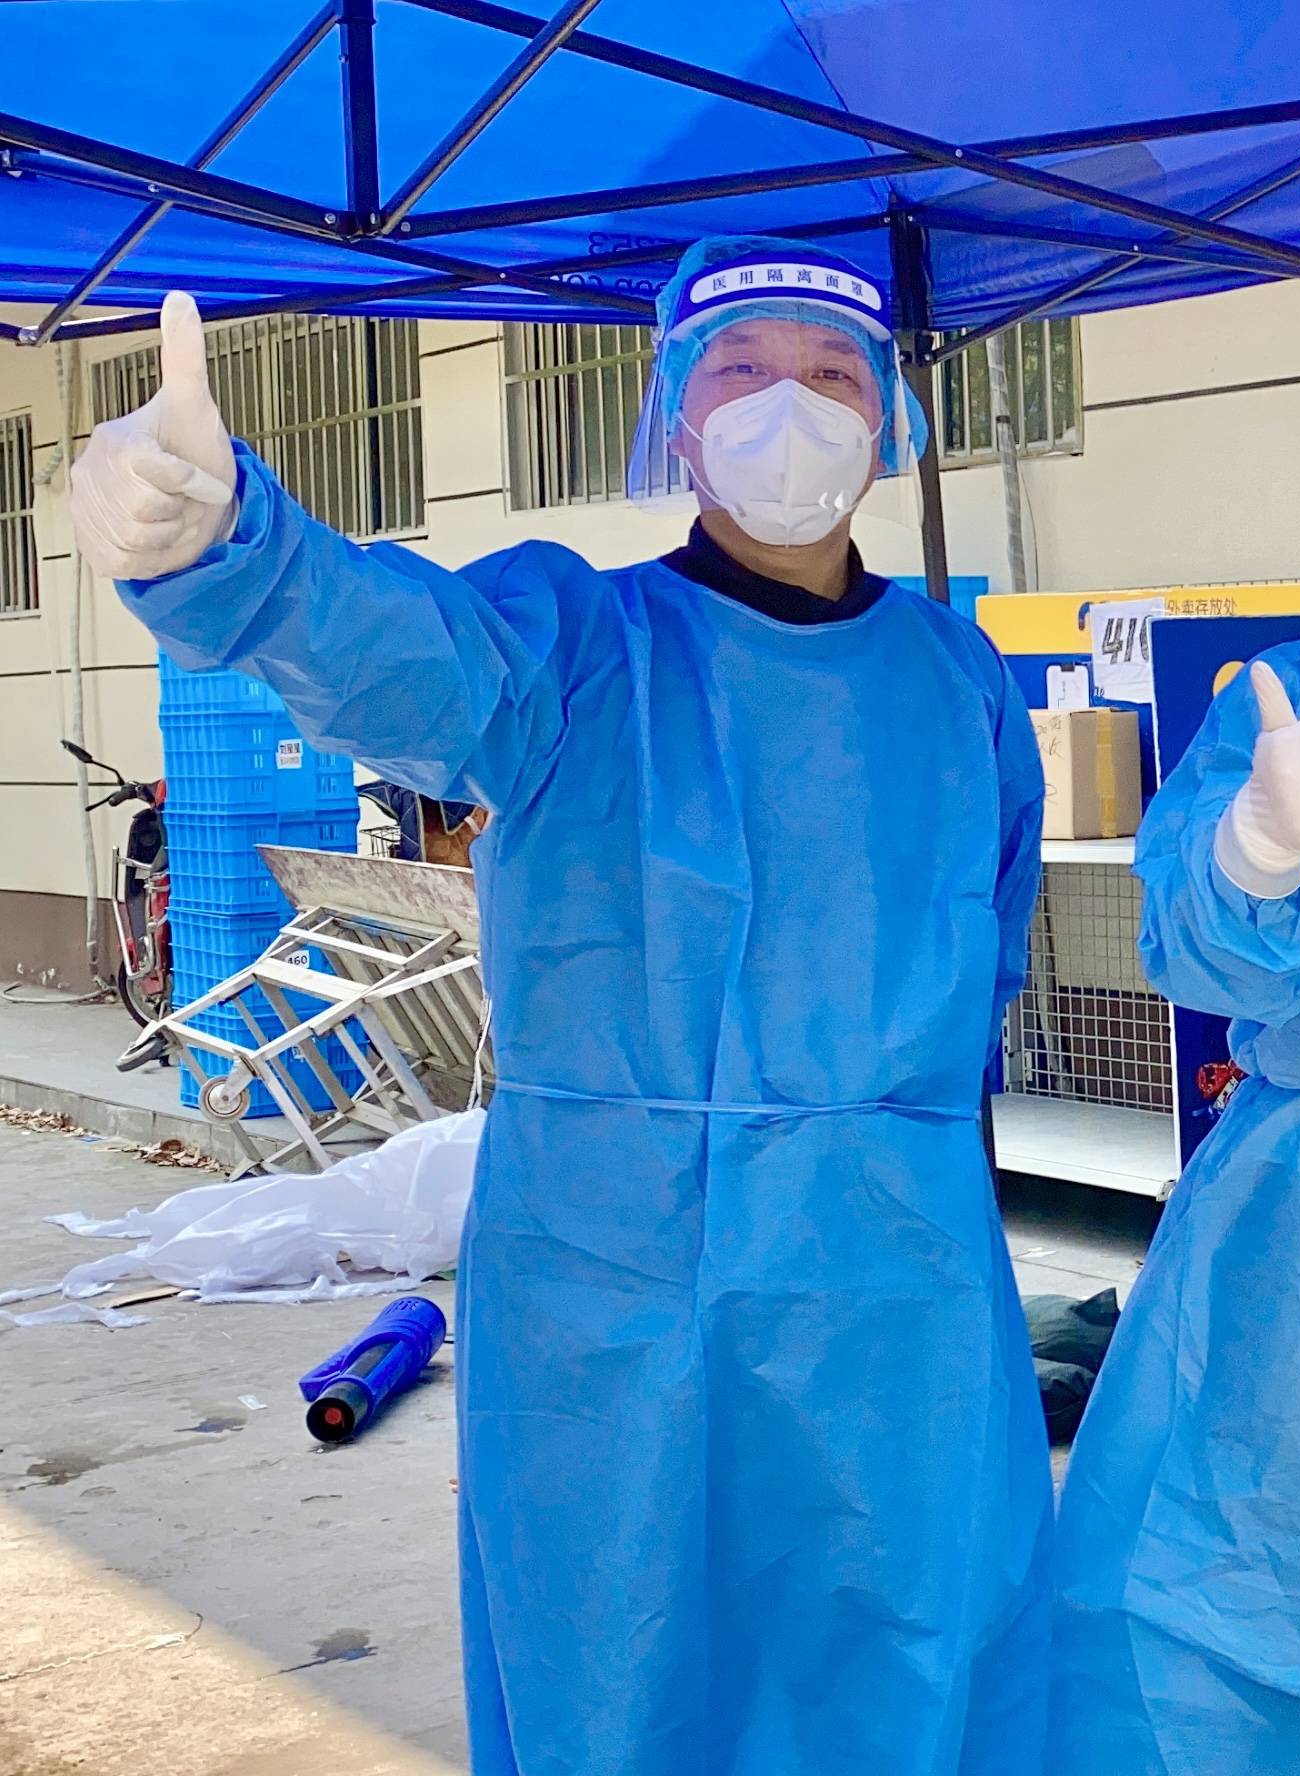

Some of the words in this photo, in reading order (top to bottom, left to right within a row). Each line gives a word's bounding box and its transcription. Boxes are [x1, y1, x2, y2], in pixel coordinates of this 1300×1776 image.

[713, 268, 863, 296] 医用隔离面罩
